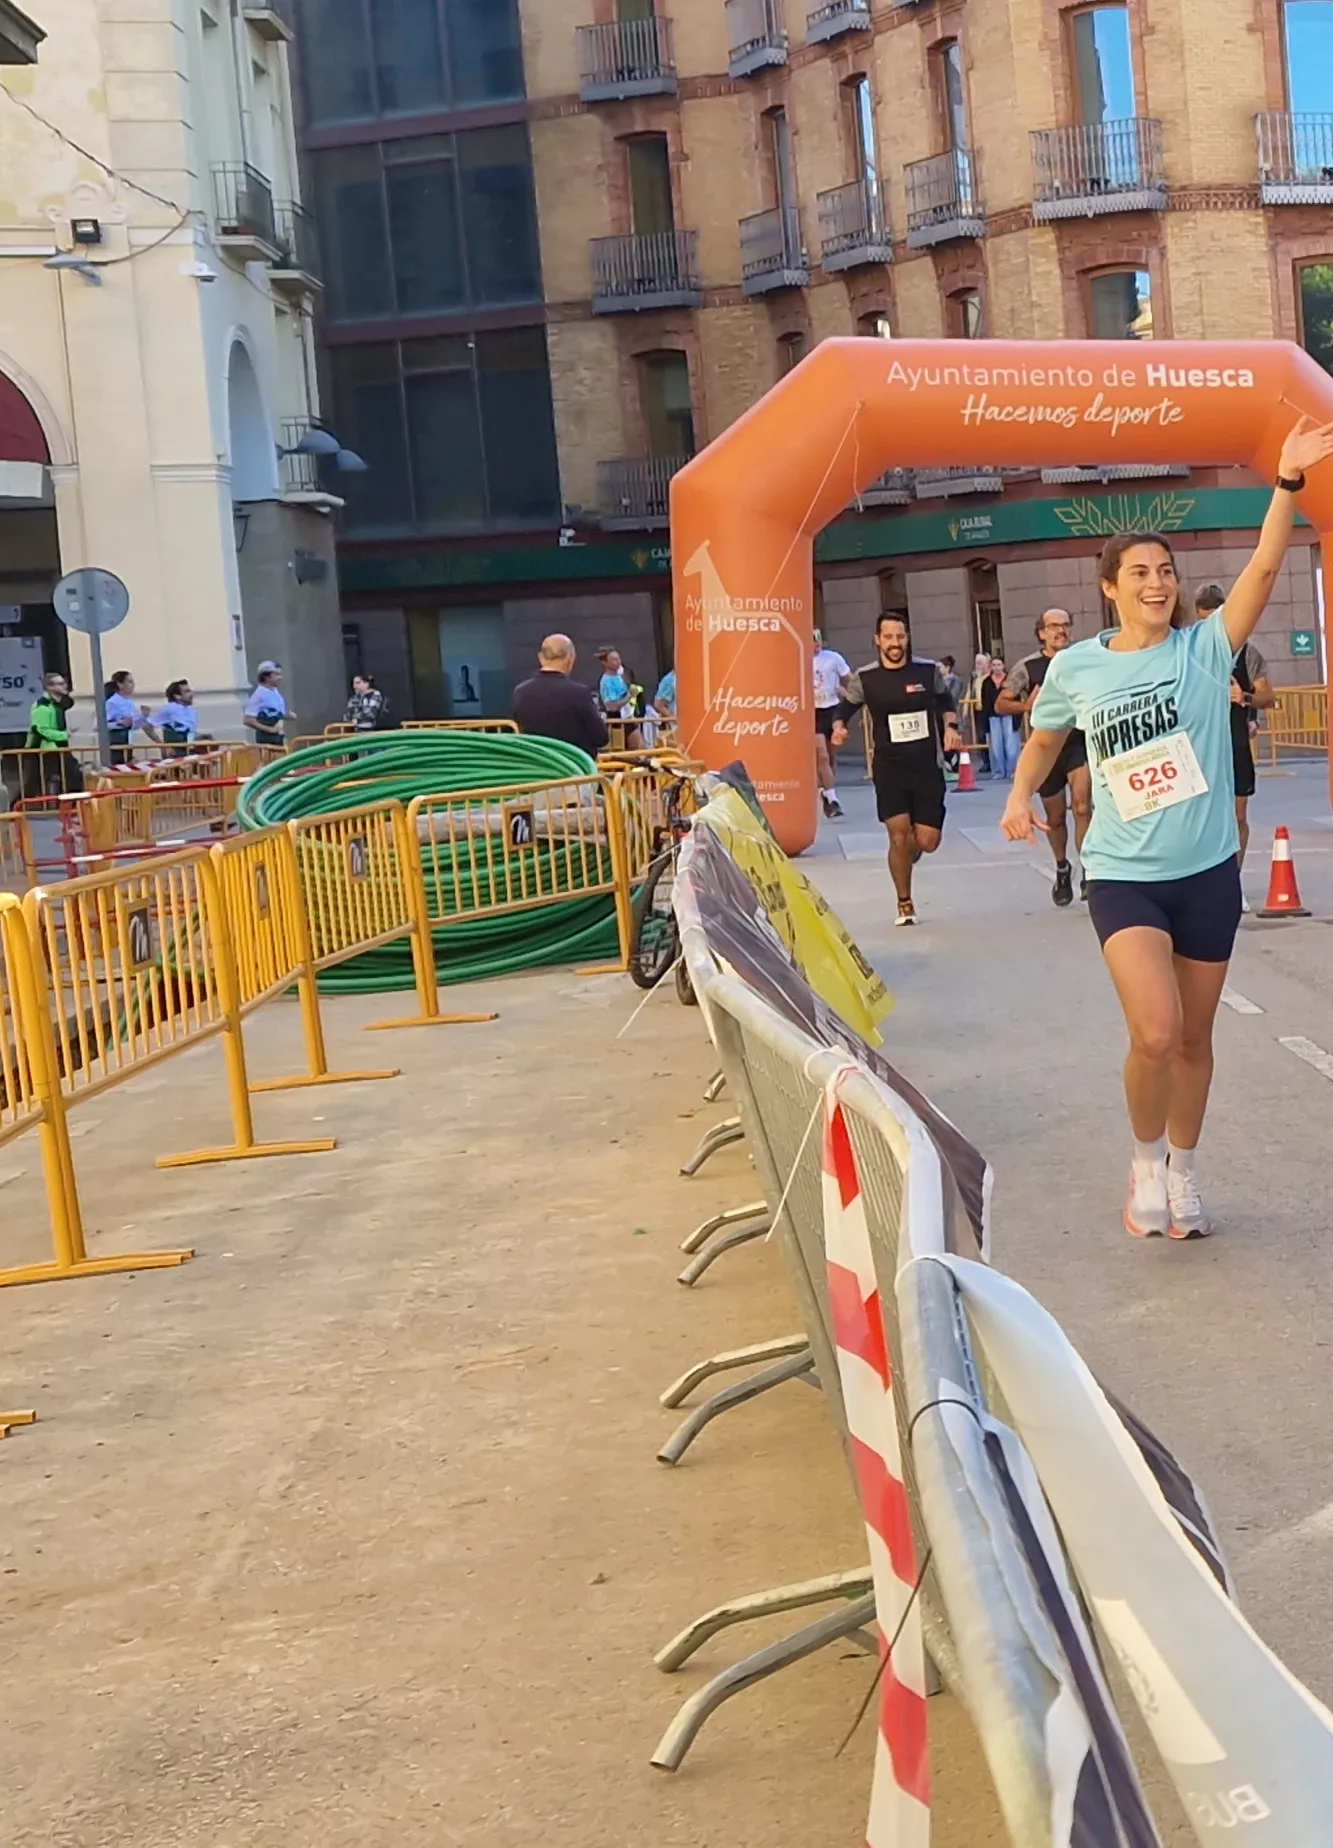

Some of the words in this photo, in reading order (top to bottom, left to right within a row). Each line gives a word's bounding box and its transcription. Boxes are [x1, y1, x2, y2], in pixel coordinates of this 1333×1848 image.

[887, 361, 1094, 391] Ayuntamiento
[1103, 363, 1136, 387] de
[1146, 363, 1254, 388] Huesca
[961, 392, 1079, 428] Hacemos
[1084, 392, 1185, 437] deporte
[685, 594, 803, 612] Ayuntamiento
[686, 614, 703, 633] de
[708, 614, 781, 633] Huesca
[712, 686, 800, 714] Hacemos
[1092, 709, 1105, 730] III
[1108, 693, 1159, 721] CARRERA
[713, 710, 791, 746] deporte
[1129, 760, 1178, 791] 626
[757, 792, 785, 801] esca
[1145, 784, 1175, 800] JARA
